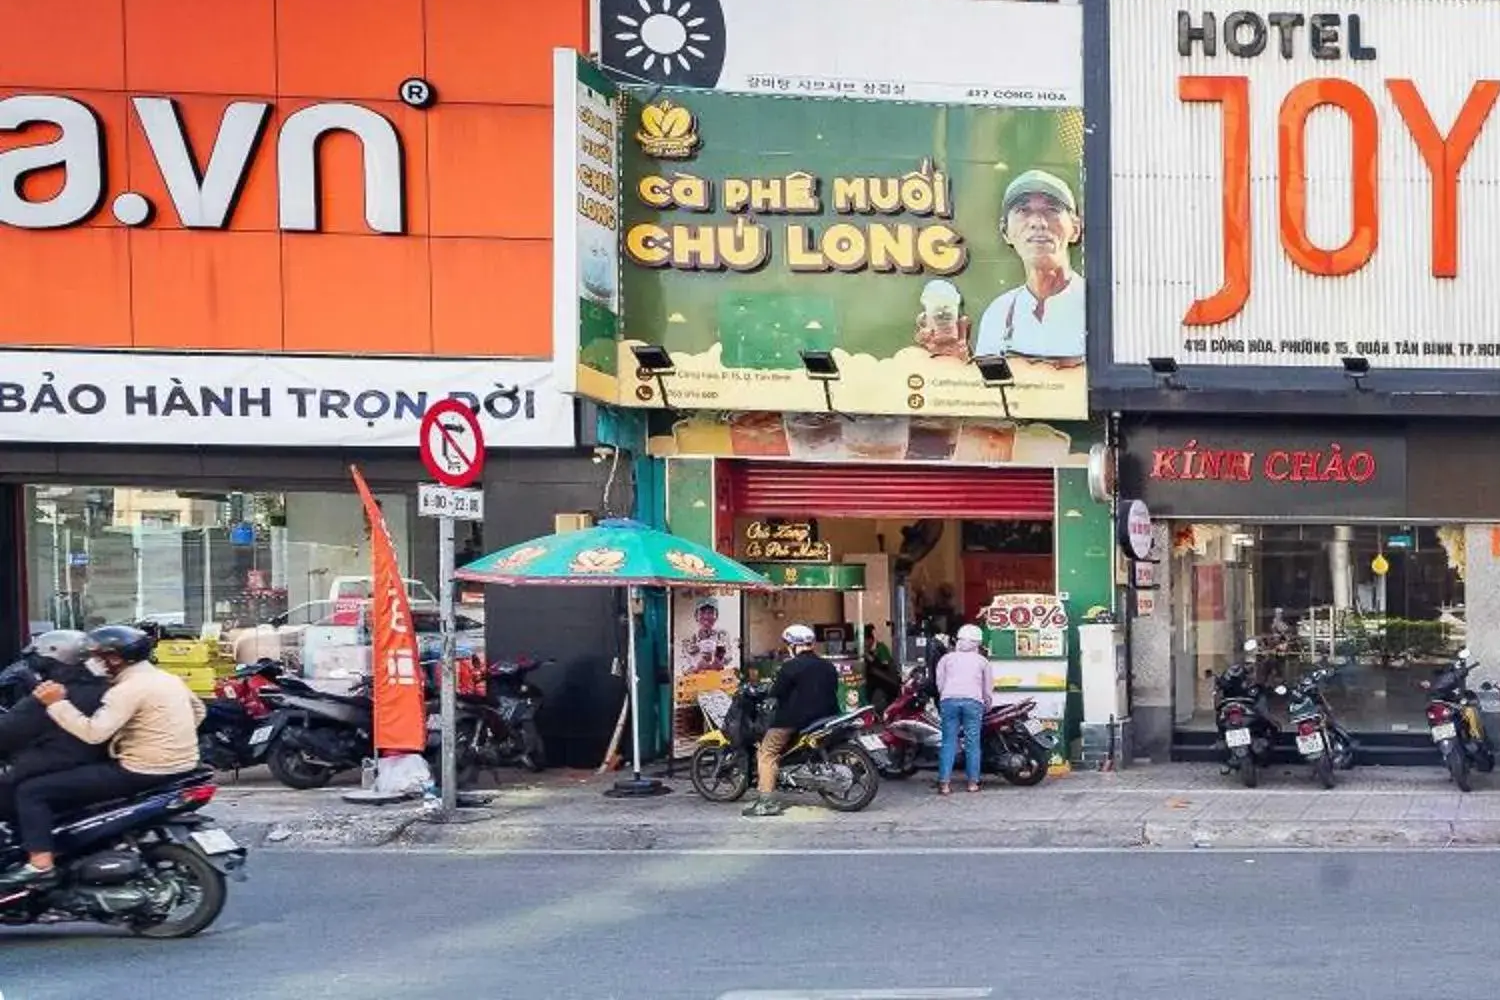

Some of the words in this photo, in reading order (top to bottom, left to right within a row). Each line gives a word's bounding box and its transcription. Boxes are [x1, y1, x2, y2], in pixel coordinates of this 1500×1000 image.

[1177, 9, 1377, 62] HOTEL
[723, 171, 818, 212] PHÊ
[625, 214, 769, 271] CHÚ
[785, 222, 968, 275] LONG
[0, 372, 106, 417] BẢO
[124, 377, 271, 419] HÀNH
[287, 387, 428, 428] TRỌN
[1149, 439, 1255, 482] KÍNH
[1264, 443, 1376, 484] CHÀO
[987, 606, 1068, 629] 50%
